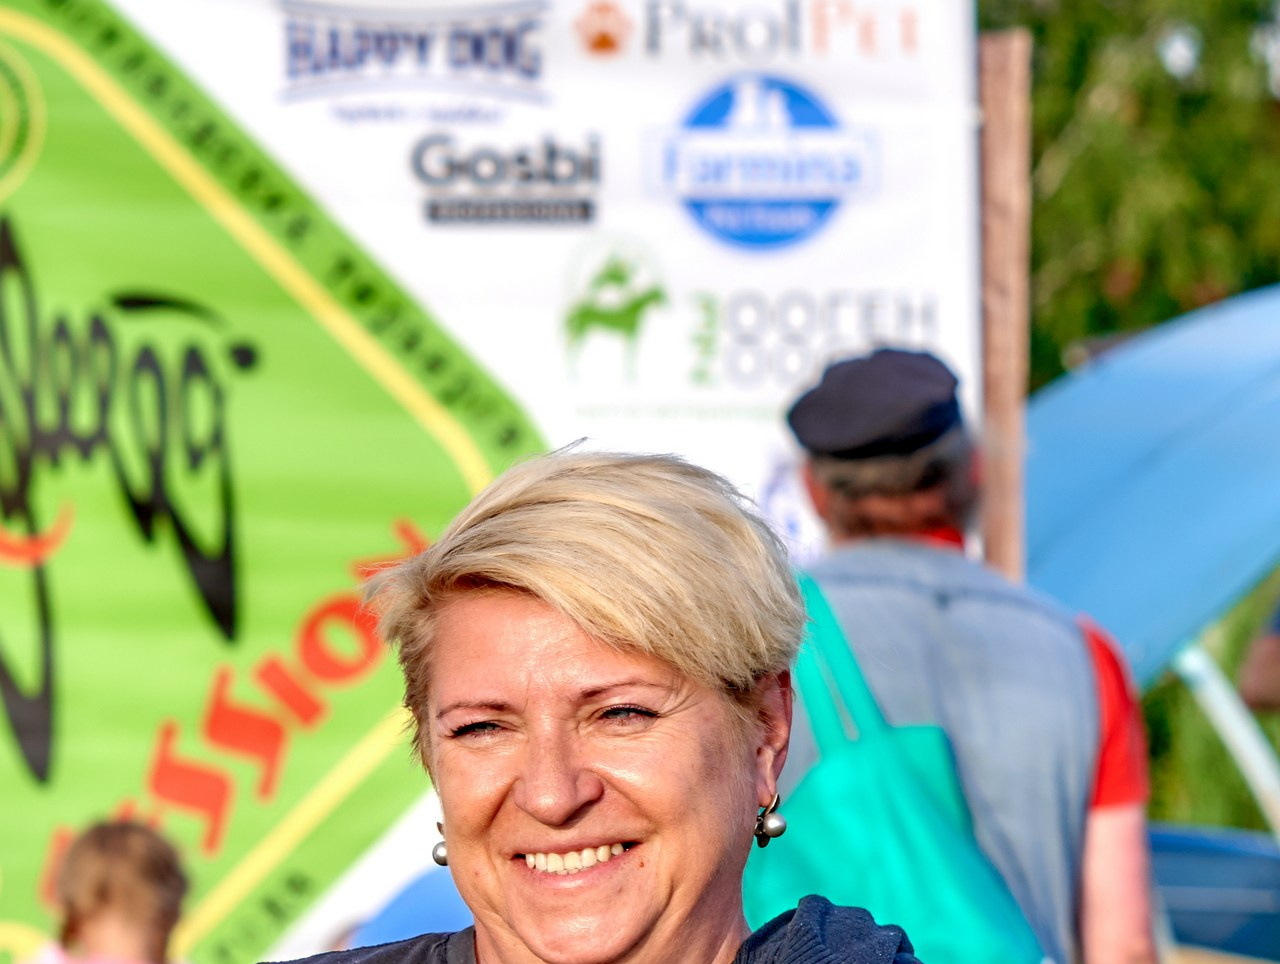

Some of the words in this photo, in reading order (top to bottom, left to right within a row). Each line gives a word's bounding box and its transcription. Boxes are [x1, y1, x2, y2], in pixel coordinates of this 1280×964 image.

[285, 18, 429, 78] HAPPY
[448, 18, 542, 80] DOG
[410, 132, 602, 188] Gosbi
